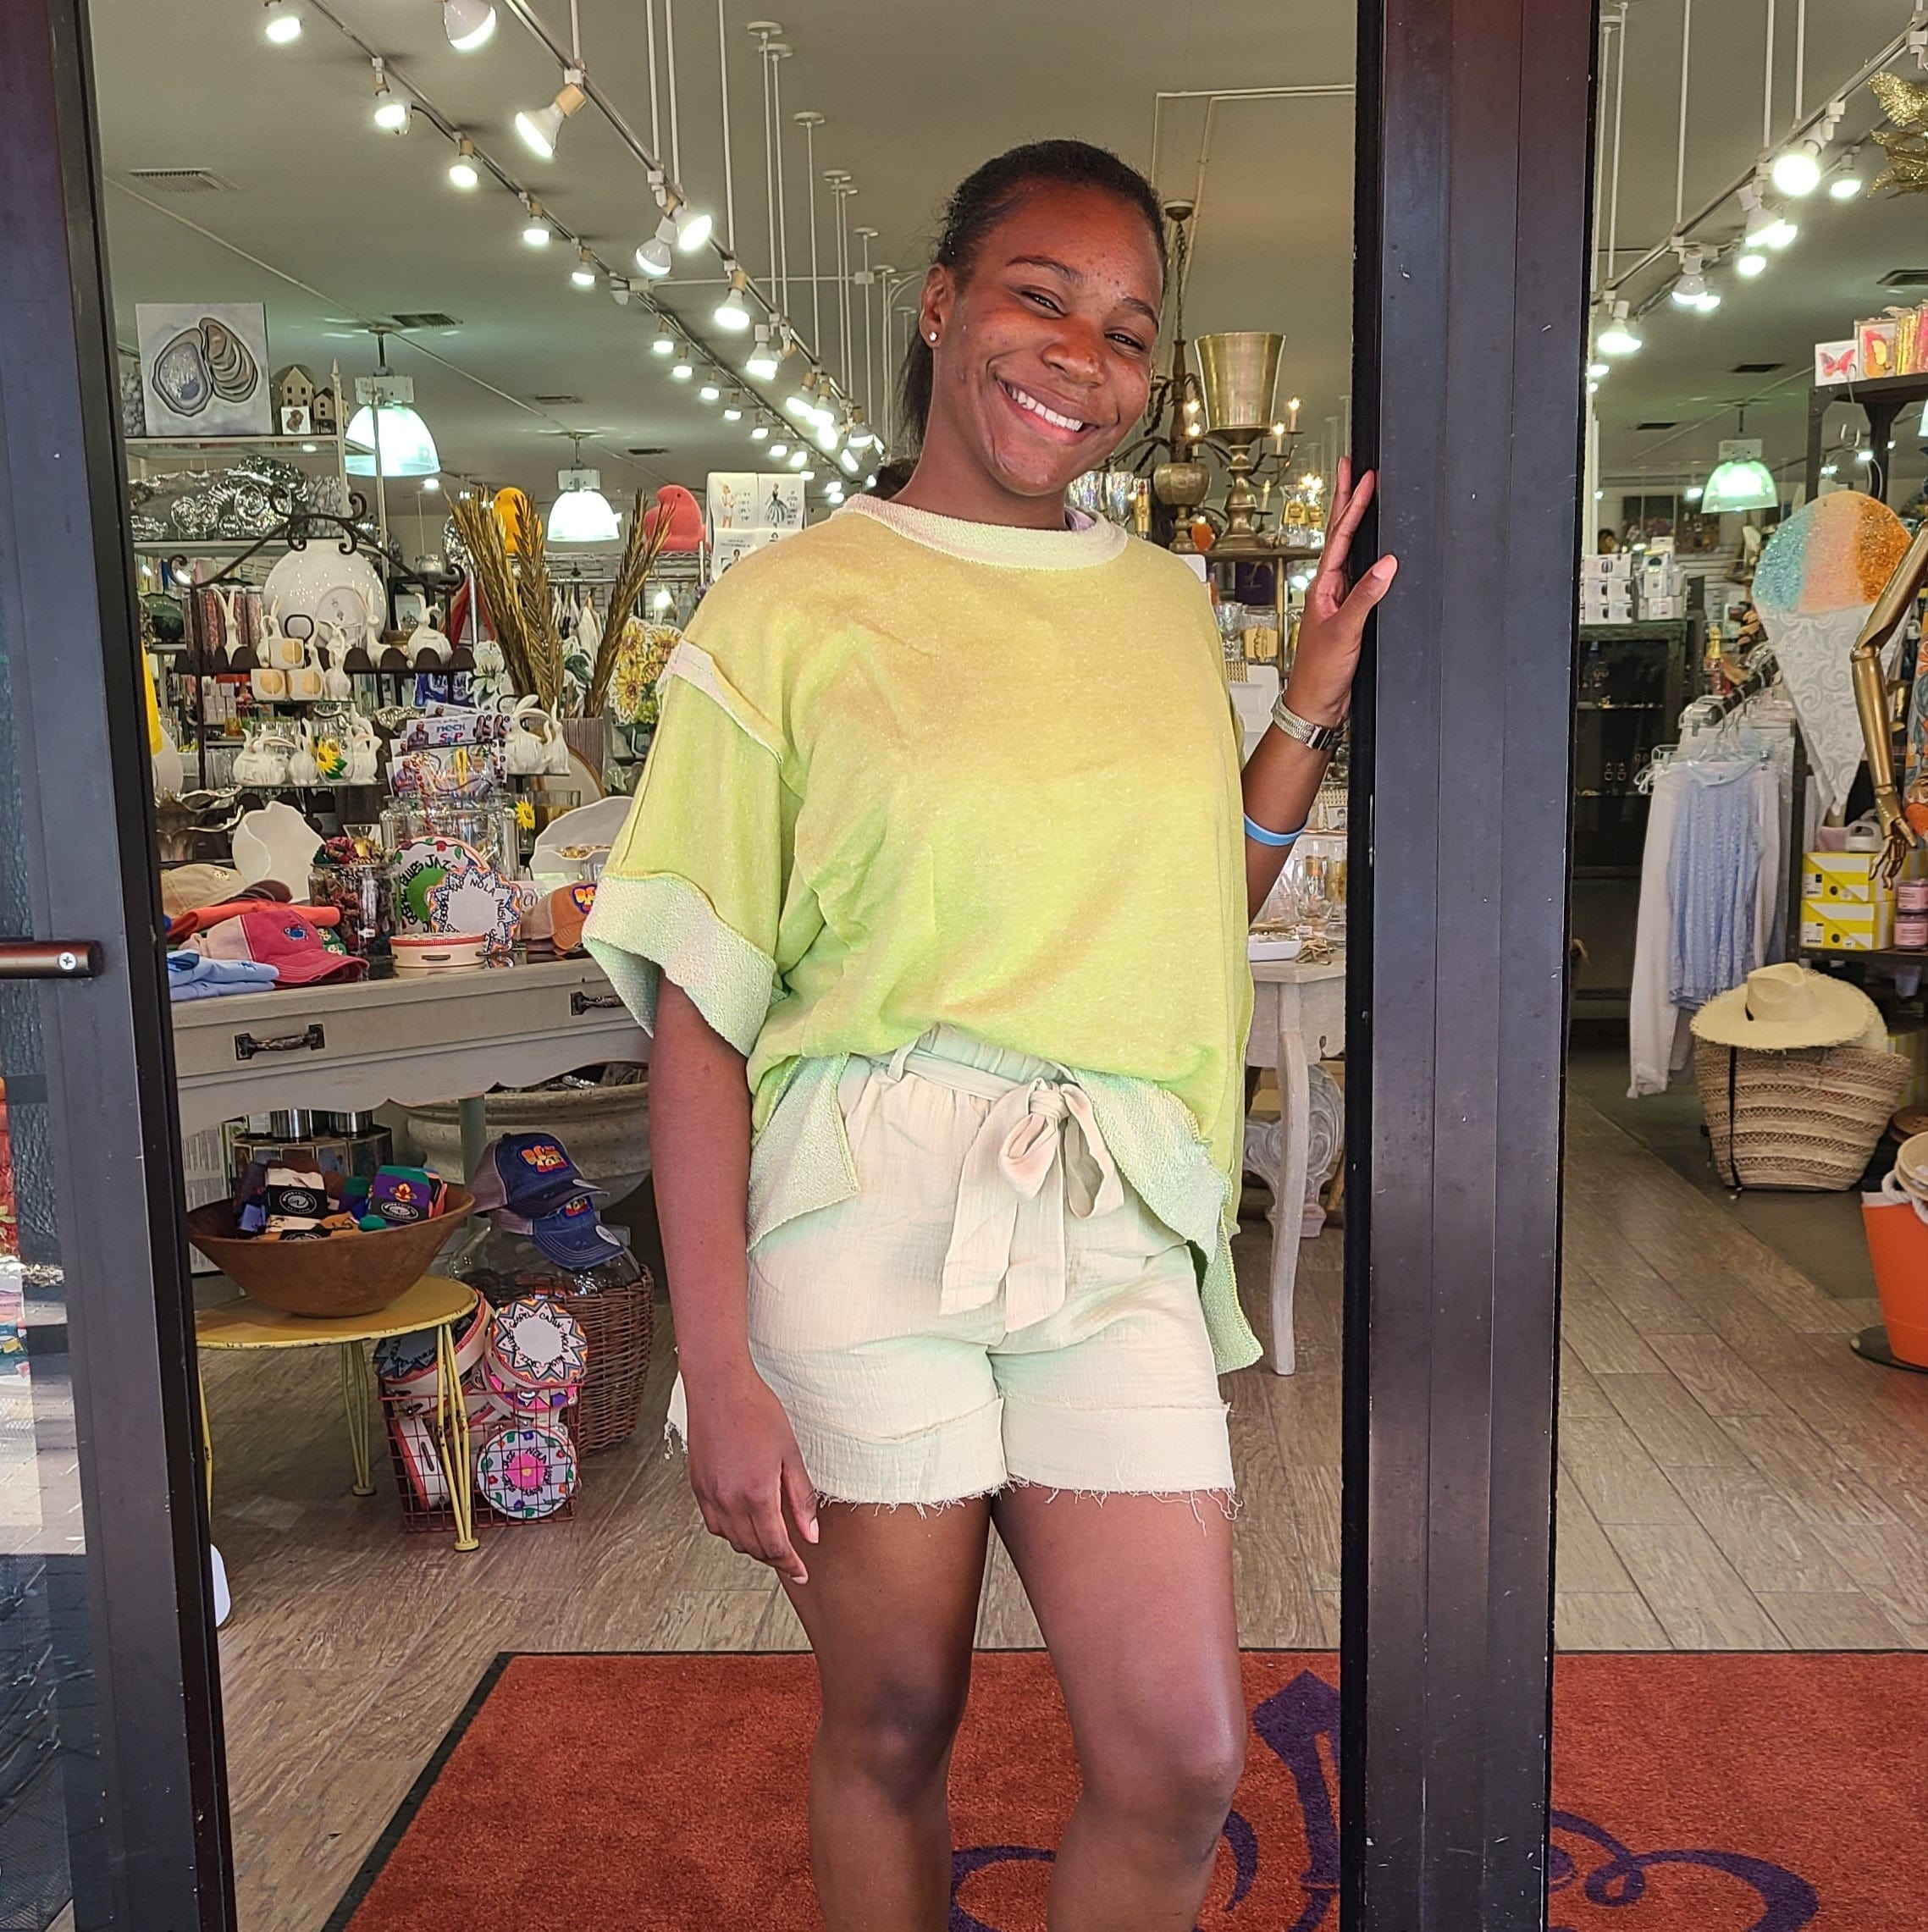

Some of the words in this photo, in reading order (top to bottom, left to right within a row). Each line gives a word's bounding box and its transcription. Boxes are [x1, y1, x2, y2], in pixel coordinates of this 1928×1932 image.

[400, 860, 423, 887] BLUES
[439, 891, 450, 923] GOSPEL
[470, 877, 496, 897] NOLA
[494, 898, 505, 928] MUSIC
[559, 1331, 569, 1354] NOLA
